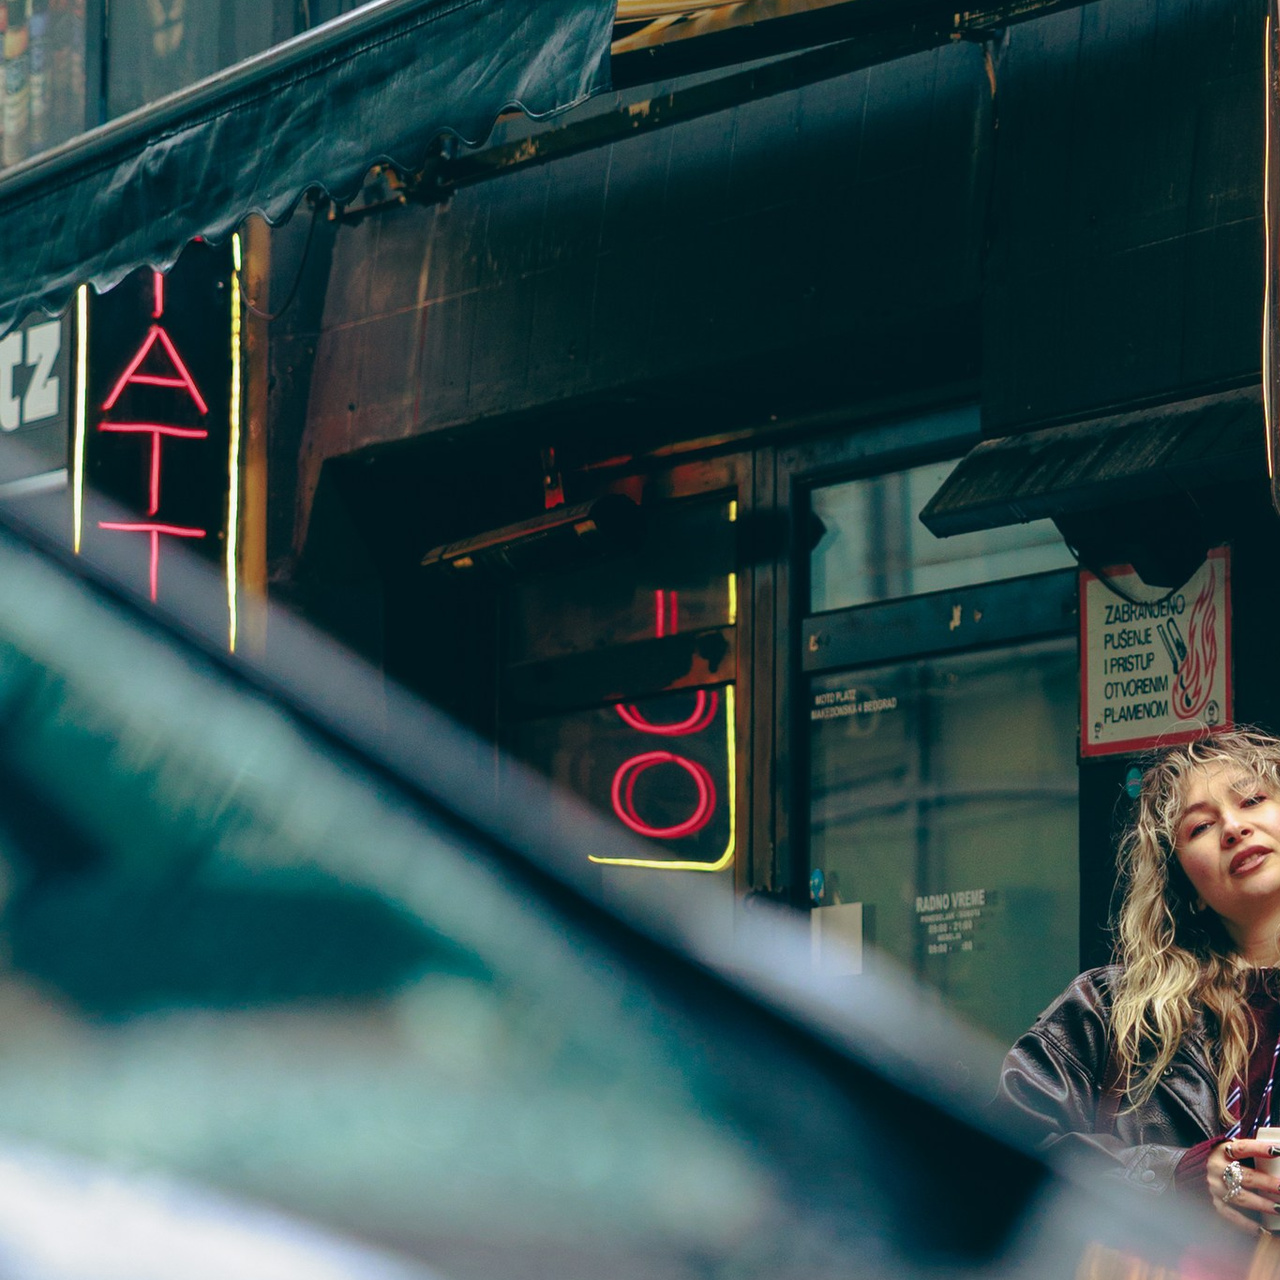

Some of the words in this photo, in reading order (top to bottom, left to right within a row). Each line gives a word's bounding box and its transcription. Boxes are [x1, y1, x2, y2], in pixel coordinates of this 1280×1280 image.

[1104, 594, 1186, 625] ZABRANJENO
[1104, 627, 1153, 650] PUŠENJE
[1110, 652, 1155, 673] PRISTUP
[1104, 674, 1169, 700] OTVORENIM
[1104, 700, 1169, 724] PLAMENOM
[915, 893, 950, 912] RADNO
[950, 888, 986, 908] VREME
